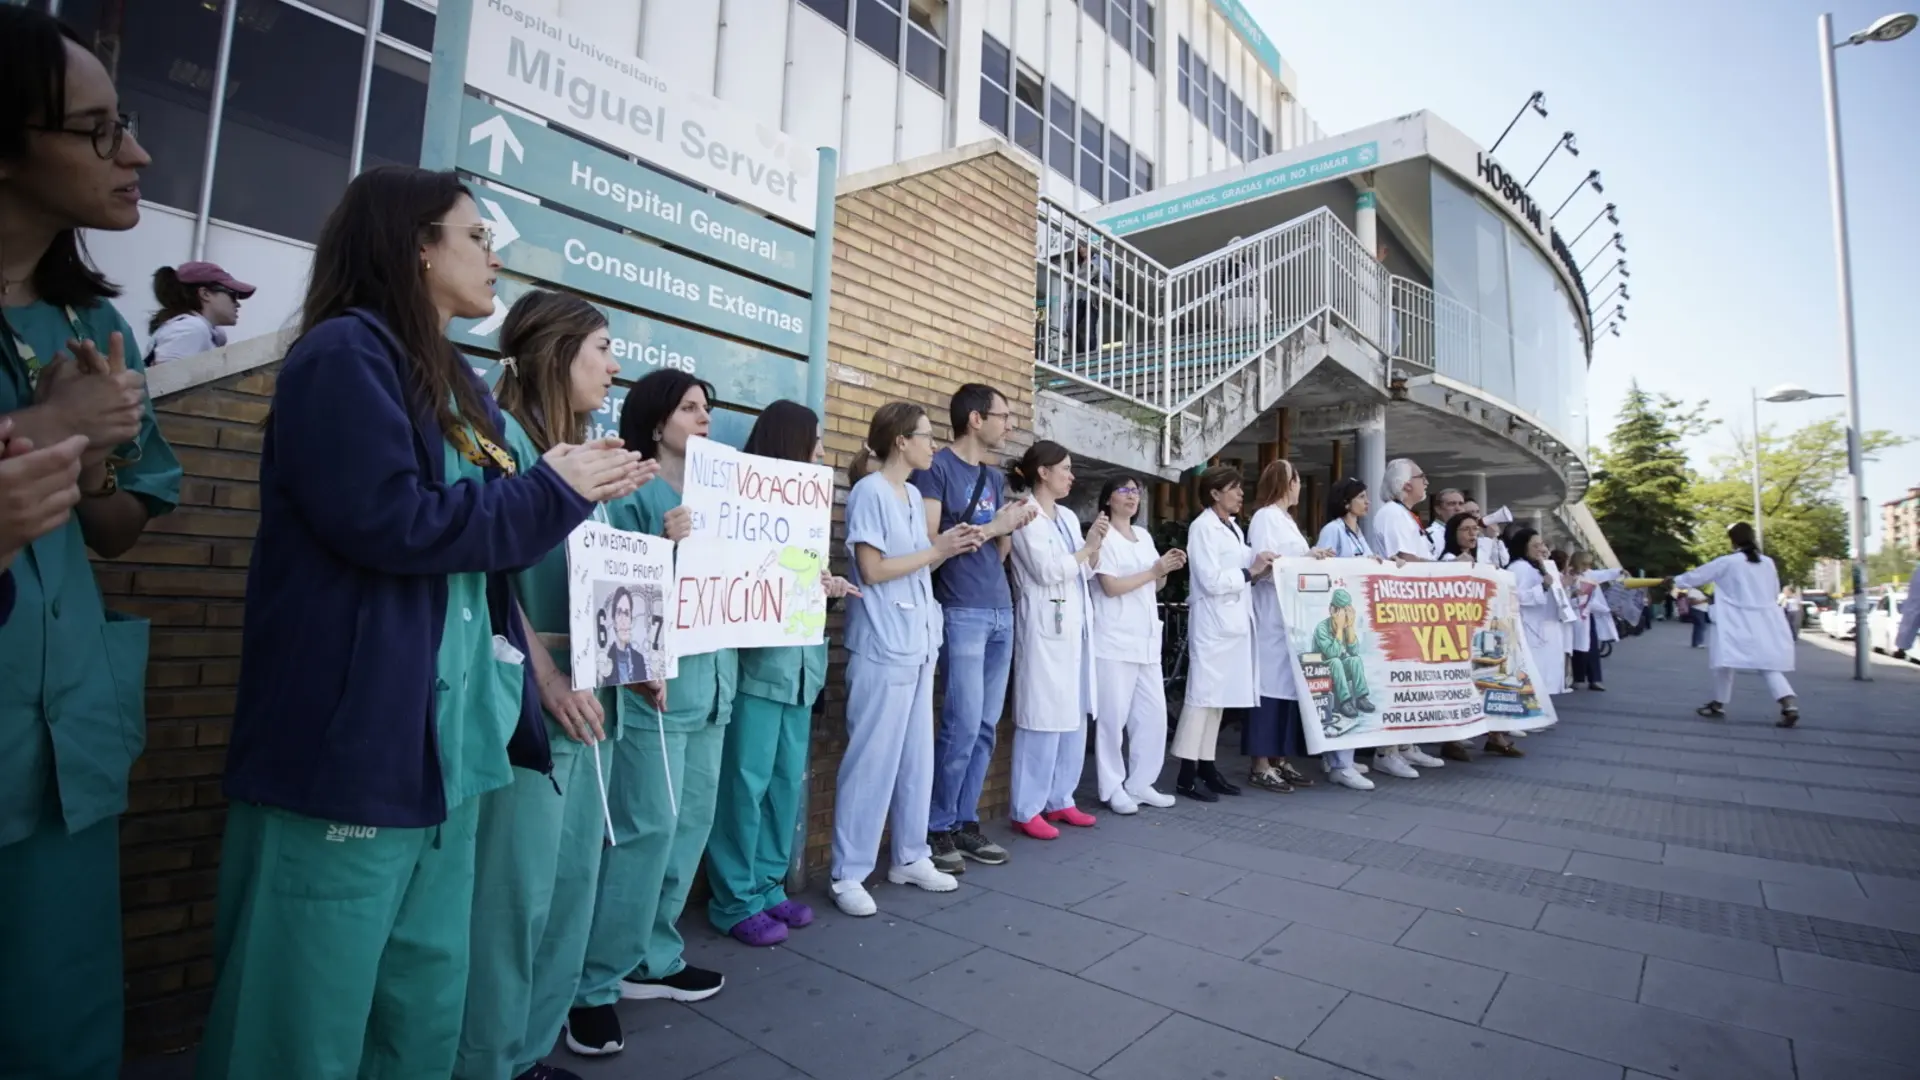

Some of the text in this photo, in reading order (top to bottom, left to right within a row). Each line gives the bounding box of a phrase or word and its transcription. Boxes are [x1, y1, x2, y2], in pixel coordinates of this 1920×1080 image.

[488, 0, 668, 93] Hospital Universitario
[507, 36, 797, 203] Miguel Servet
[571, 160, 777, 260] Hospital General
[1116, 215, 1139, 229] ZONA
[1167, 203, 1180, 214] DE
[1222, 180, 1262, 200] GRACIAS
[1266, 174, 1287, 188] POR
[1310, 156, 1349, 175] FUMAR
[564, 238, 803, 333] Consultas Externas
[610, 337, 696, 374] encias
[693, 511, 706, 530] EN
[809, 527, 824, 539] DE
[597, 608, 608, 649] 6
[652, 615, 664, 651] 7
[1376, 603, 1439, 623] ESTATUTO
[1411, 624, 1469, 661] YA!
[1308, 680, 1330, 690] ACIÓN
[1390, 670, 1412, 682] POR
[1394, 689, 1434, 702] MÁXIMA
[1382, 712, 1402, 723] POR
[1404, 711, 1416, 722] LA
